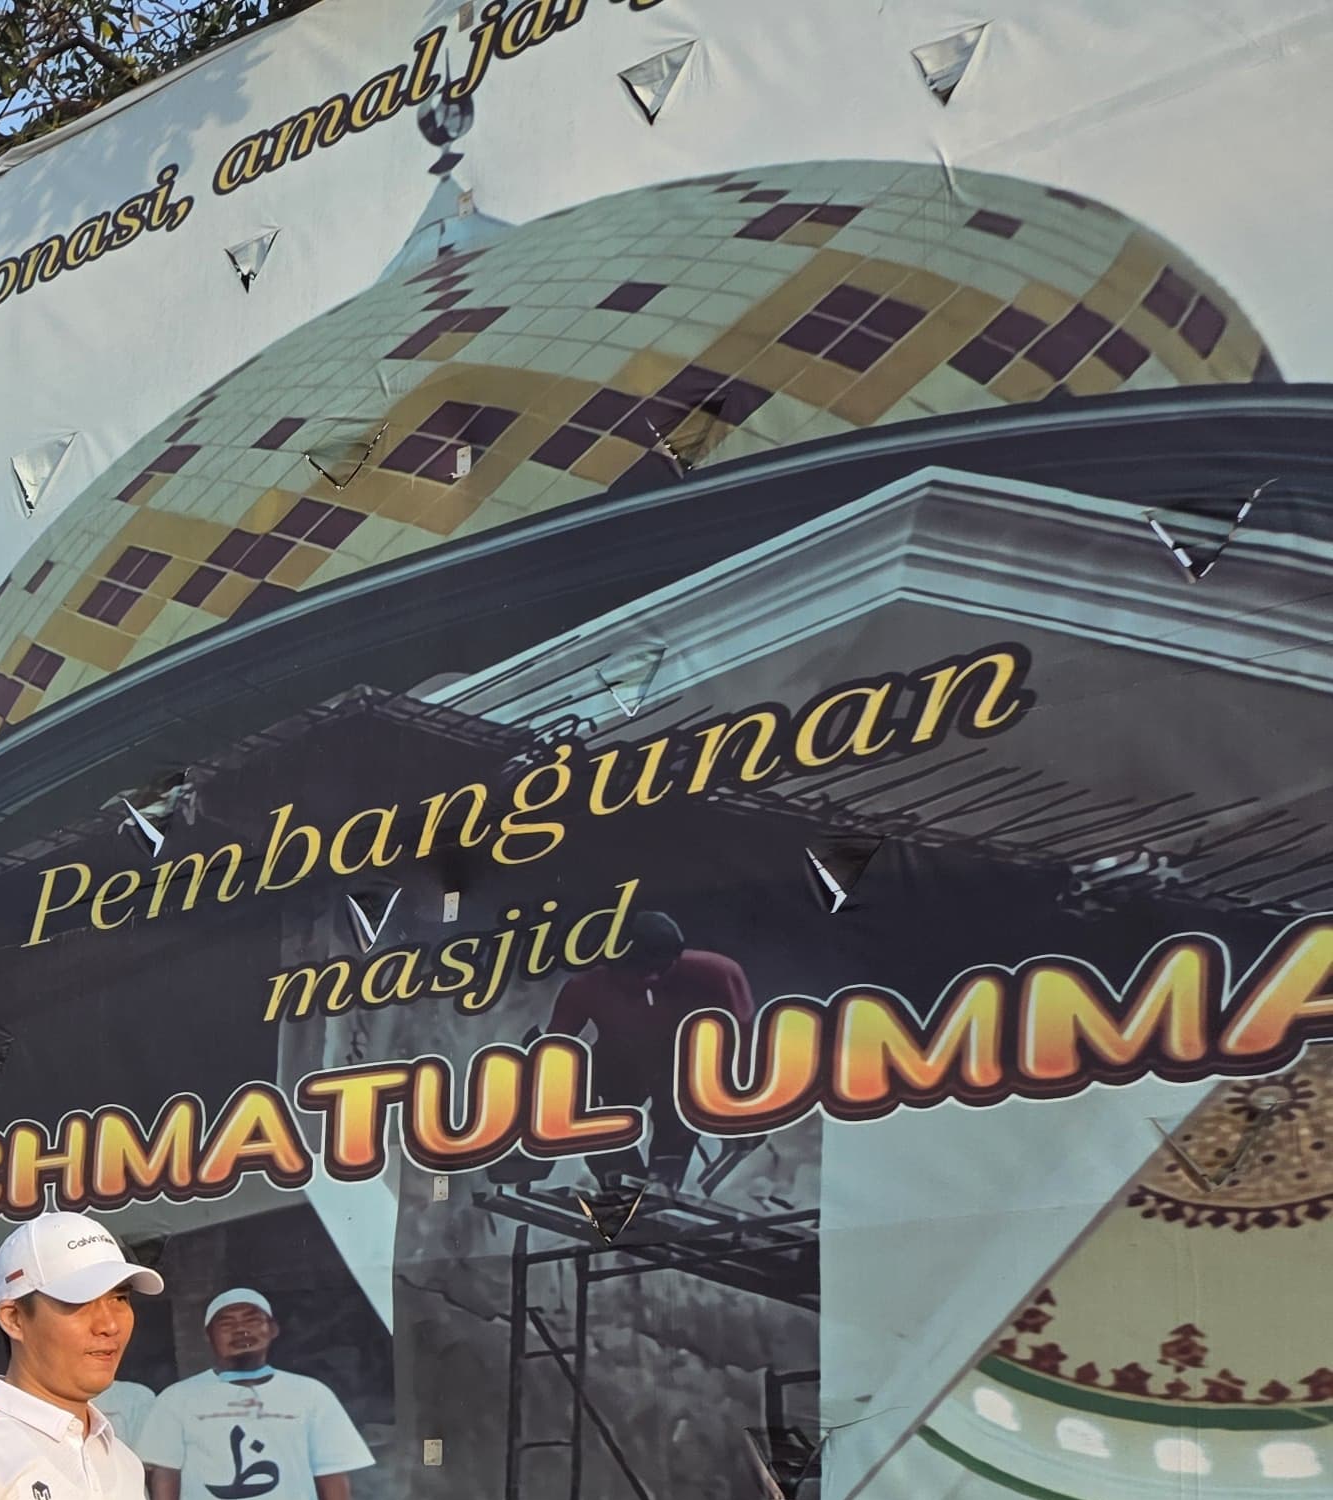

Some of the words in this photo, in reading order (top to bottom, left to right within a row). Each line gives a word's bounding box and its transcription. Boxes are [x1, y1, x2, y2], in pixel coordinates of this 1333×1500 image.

[213, 26, 447, 195] amal
[20, 648, 1023, 946] Pembangunan
[264, 877, 641, 1022] masjid
[205, 1425, 280, 1499] ظ
